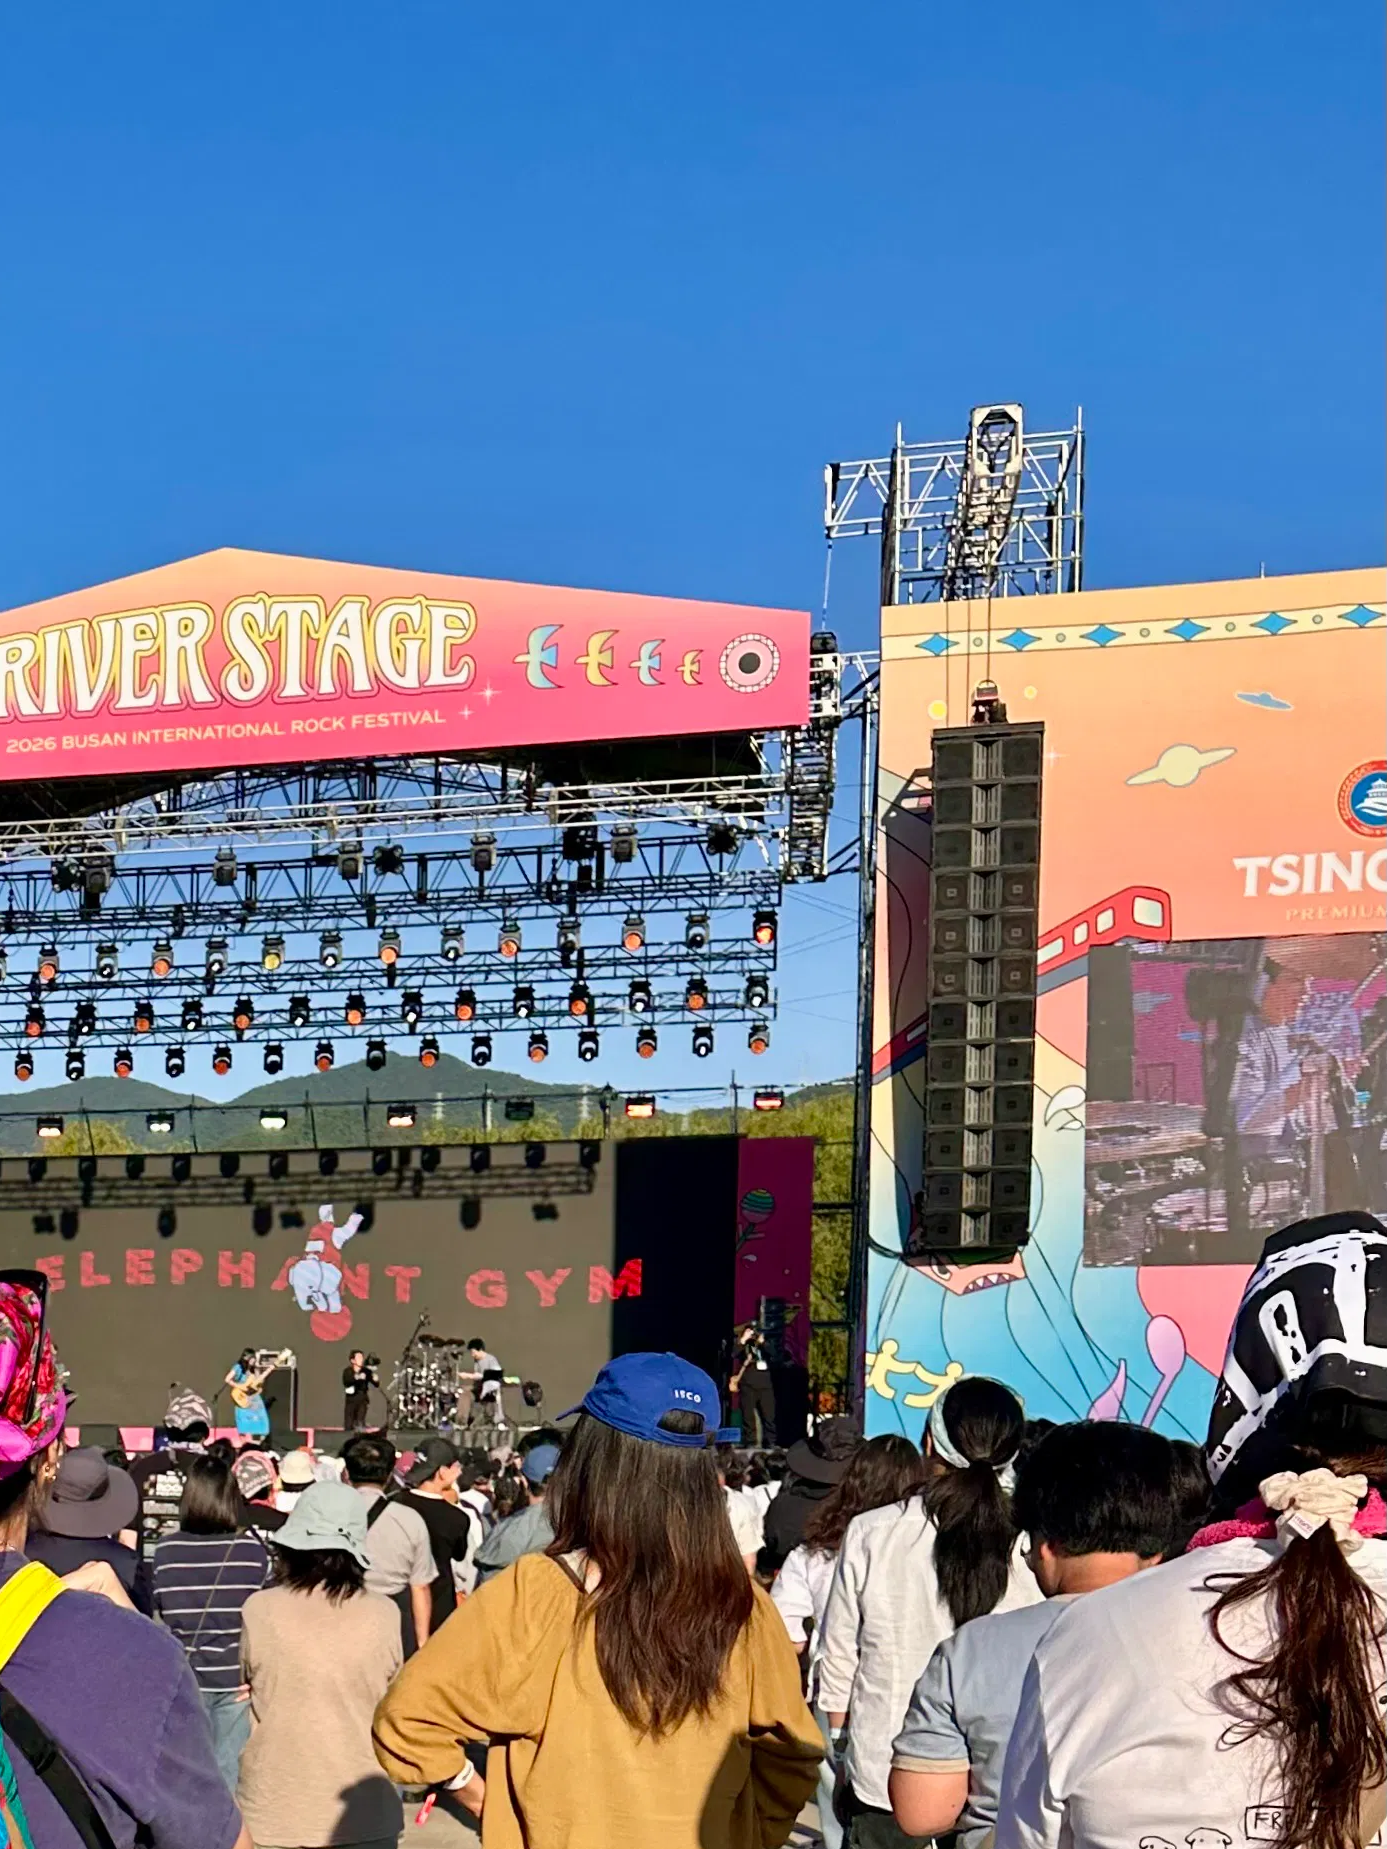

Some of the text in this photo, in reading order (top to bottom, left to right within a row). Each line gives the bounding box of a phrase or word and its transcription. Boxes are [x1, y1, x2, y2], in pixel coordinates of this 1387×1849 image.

[221, 593, 475, 706] STAGE
[6, 709, 446, 753] 2026 BUSAN INTERNATIONAL ROCK FESTIVAL
[465, 1258, 642, 1308] GYM
